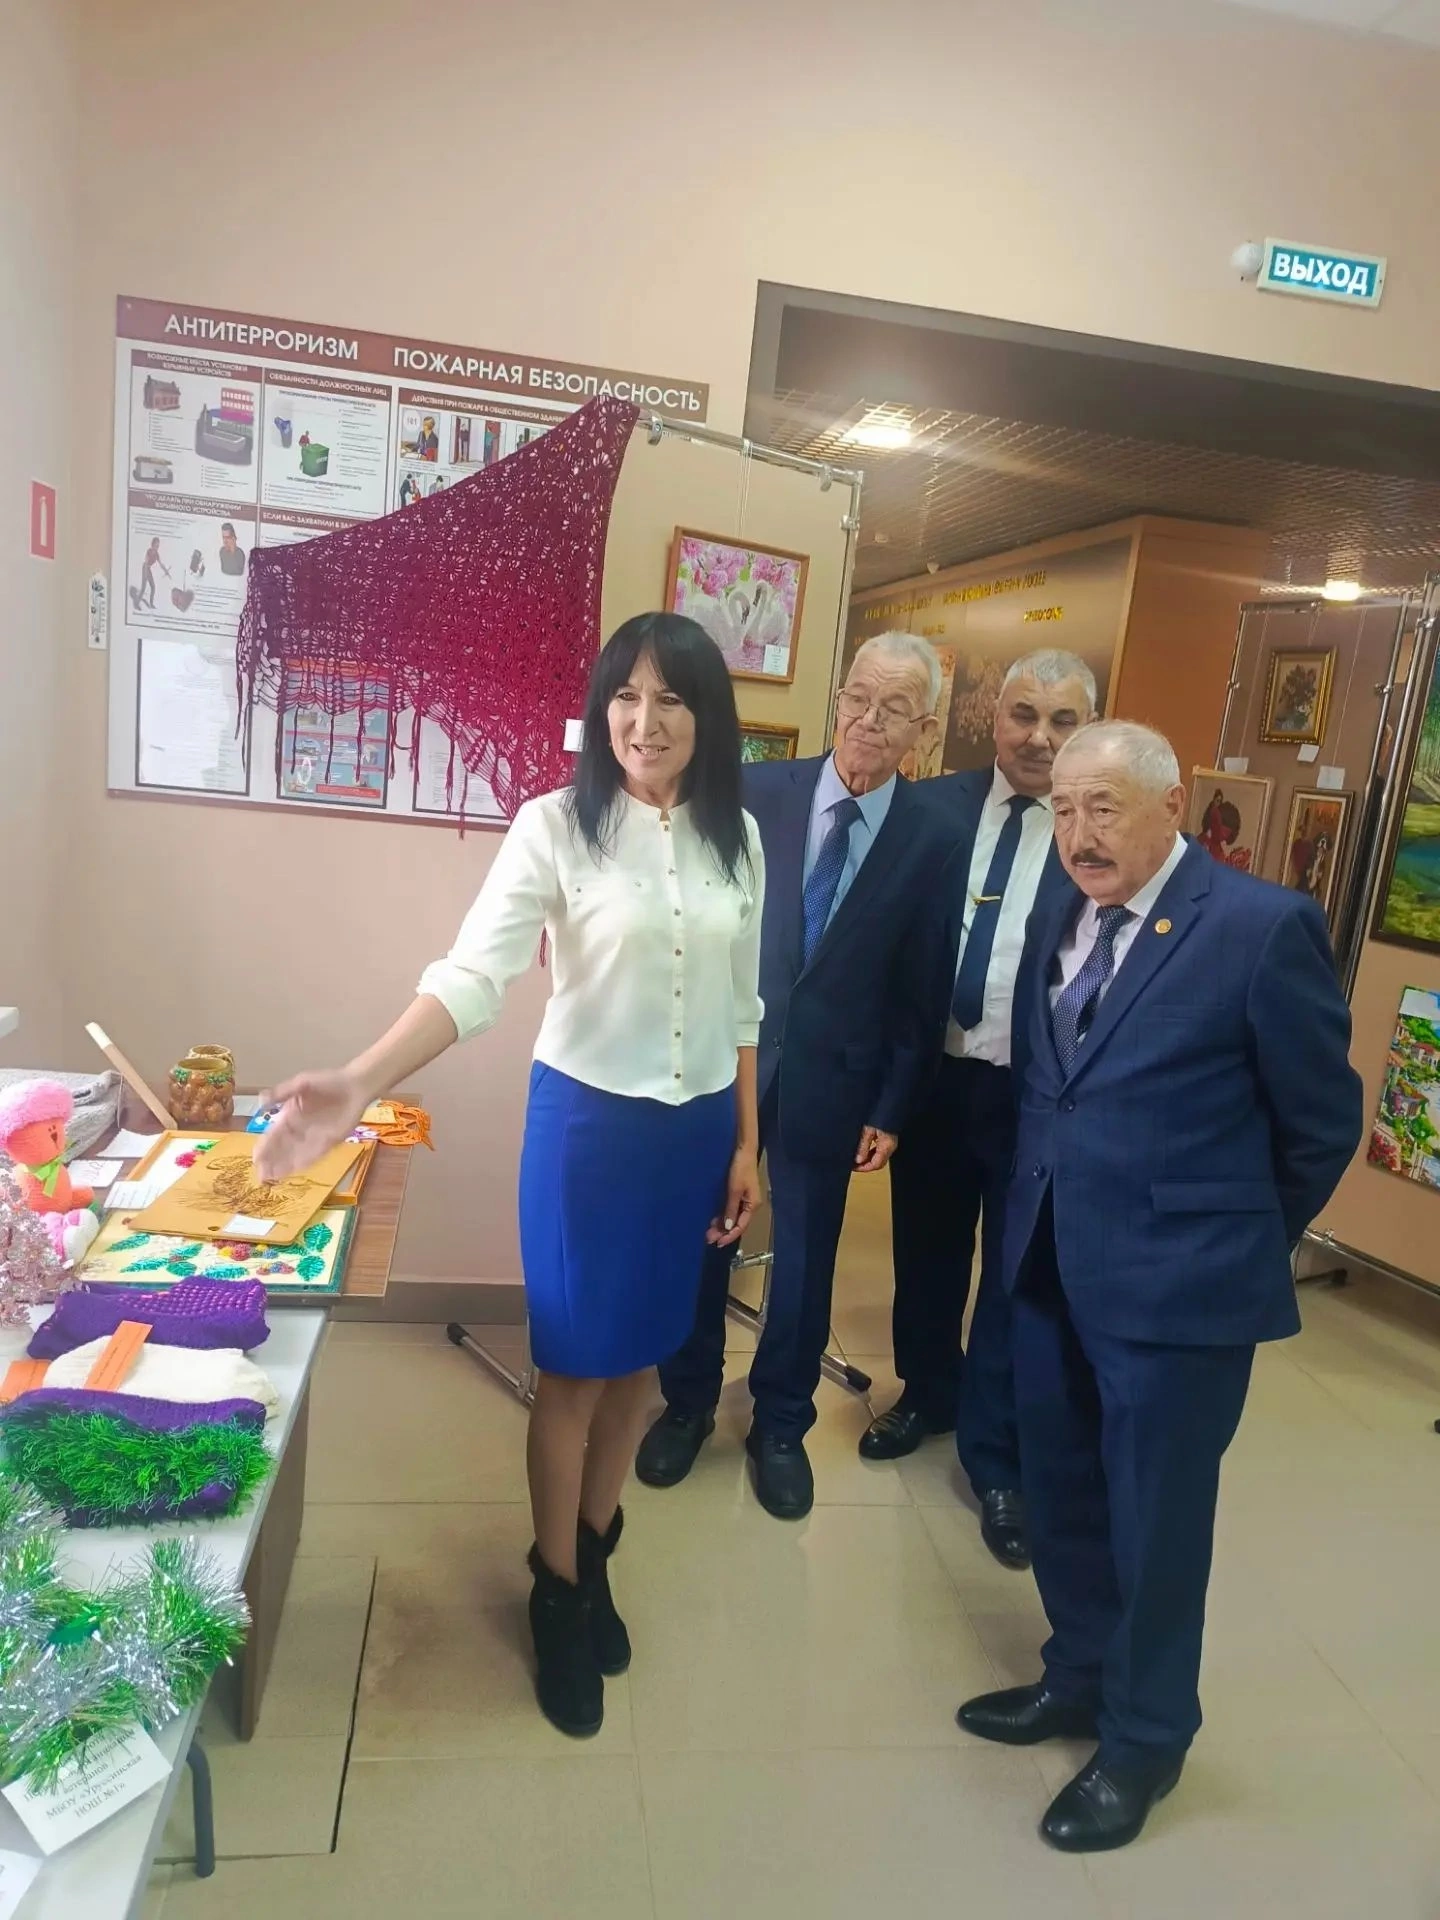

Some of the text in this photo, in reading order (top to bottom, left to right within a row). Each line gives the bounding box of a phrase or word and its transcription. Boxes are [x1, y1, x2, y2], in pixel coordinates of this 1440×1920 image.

[1273, 253, 1369, 295] ВЫХОД
[164, 314, 359, 360] АНТИТЕРРОРИЗМ
[269, 372, 318, 385] ОБЯЗАННОСТИ
[318, 380, 372, 393] ДОЛЖНОСТНЫХ
[394, 346, 700, 411] ПОЖАРНАЯ БЕЗОПАСНОСТЬ
[412, 394, 443, 405] ДЕЙСТВИЯ
[458, 401, 484, 411] ПОЖАРЕ
[490, 406, 539, 419] ОБЩЕСТВЕННОМ
[263, 512, 281, 520] ЕСЛИ
[282, 514, 296, 522] ВАС
